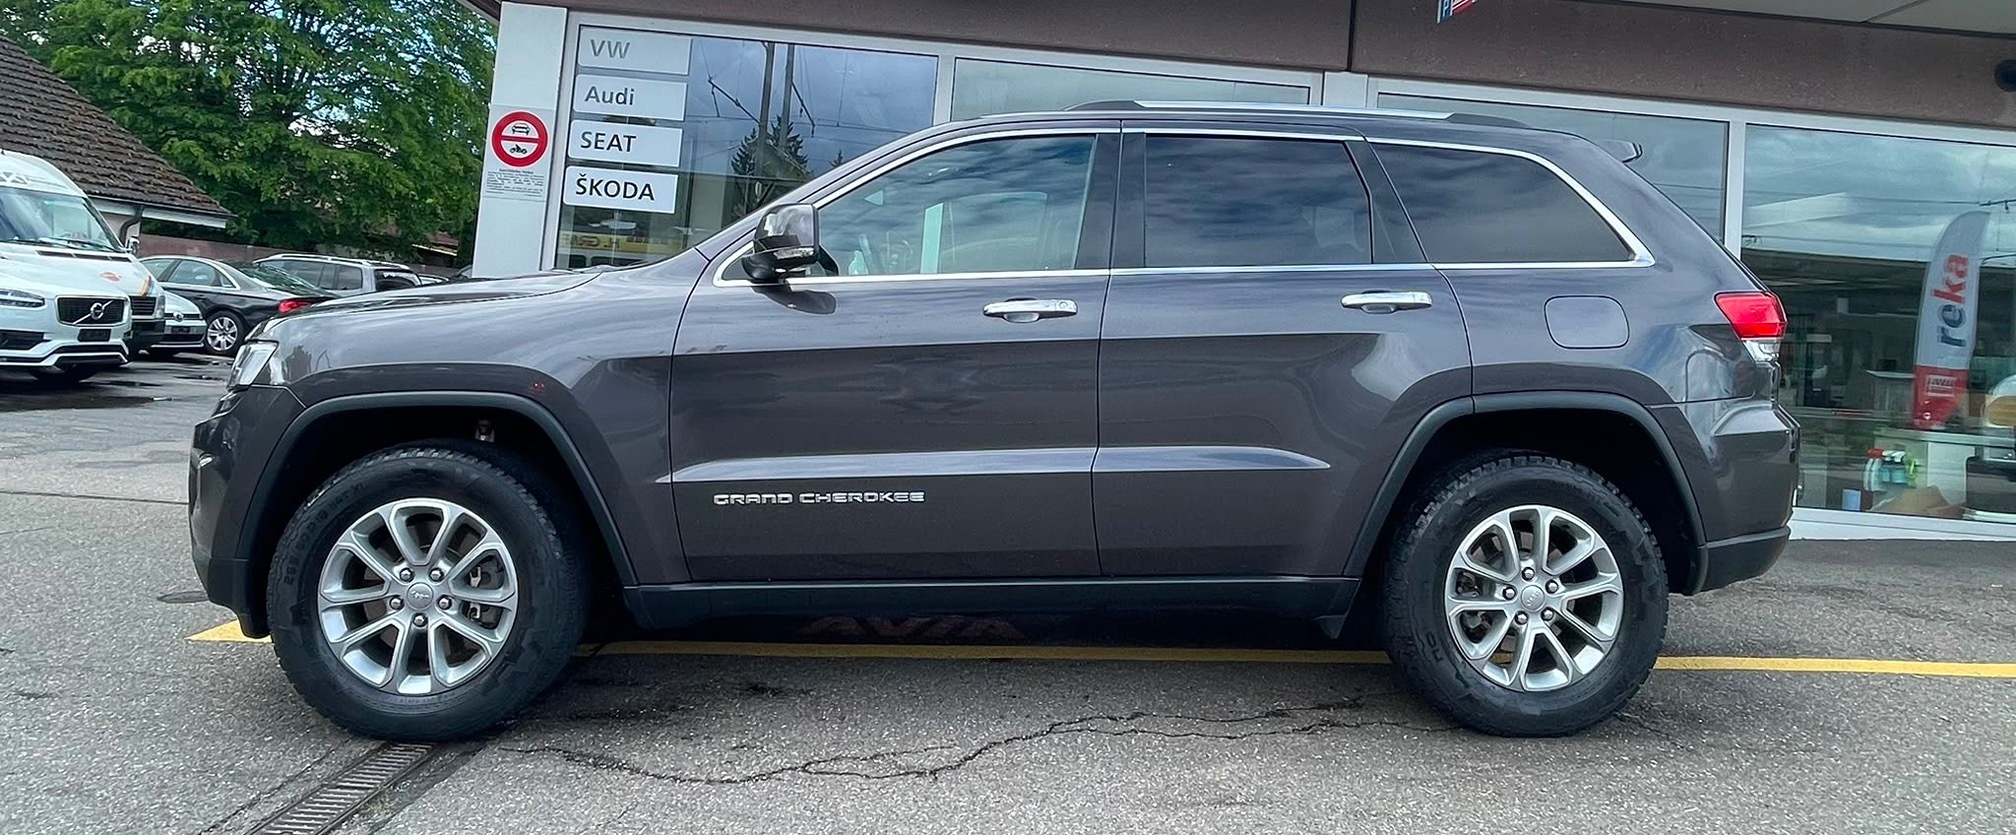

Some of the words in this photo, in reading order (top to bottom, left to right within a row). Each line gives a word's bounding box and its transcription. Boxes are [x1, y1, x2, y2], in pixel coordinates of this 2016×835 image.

[590, 38, 631, 60] VW
[584, 85, 635, 106] Audi
[579, 131, 637, 153] SEAT
[575, 173, 655, 202] ŠKODA
[1932, 254, 1969, 347] reka
[713, 493, 793, 505] GRAND
[799, 491, 925, 504] CHEROKEE
